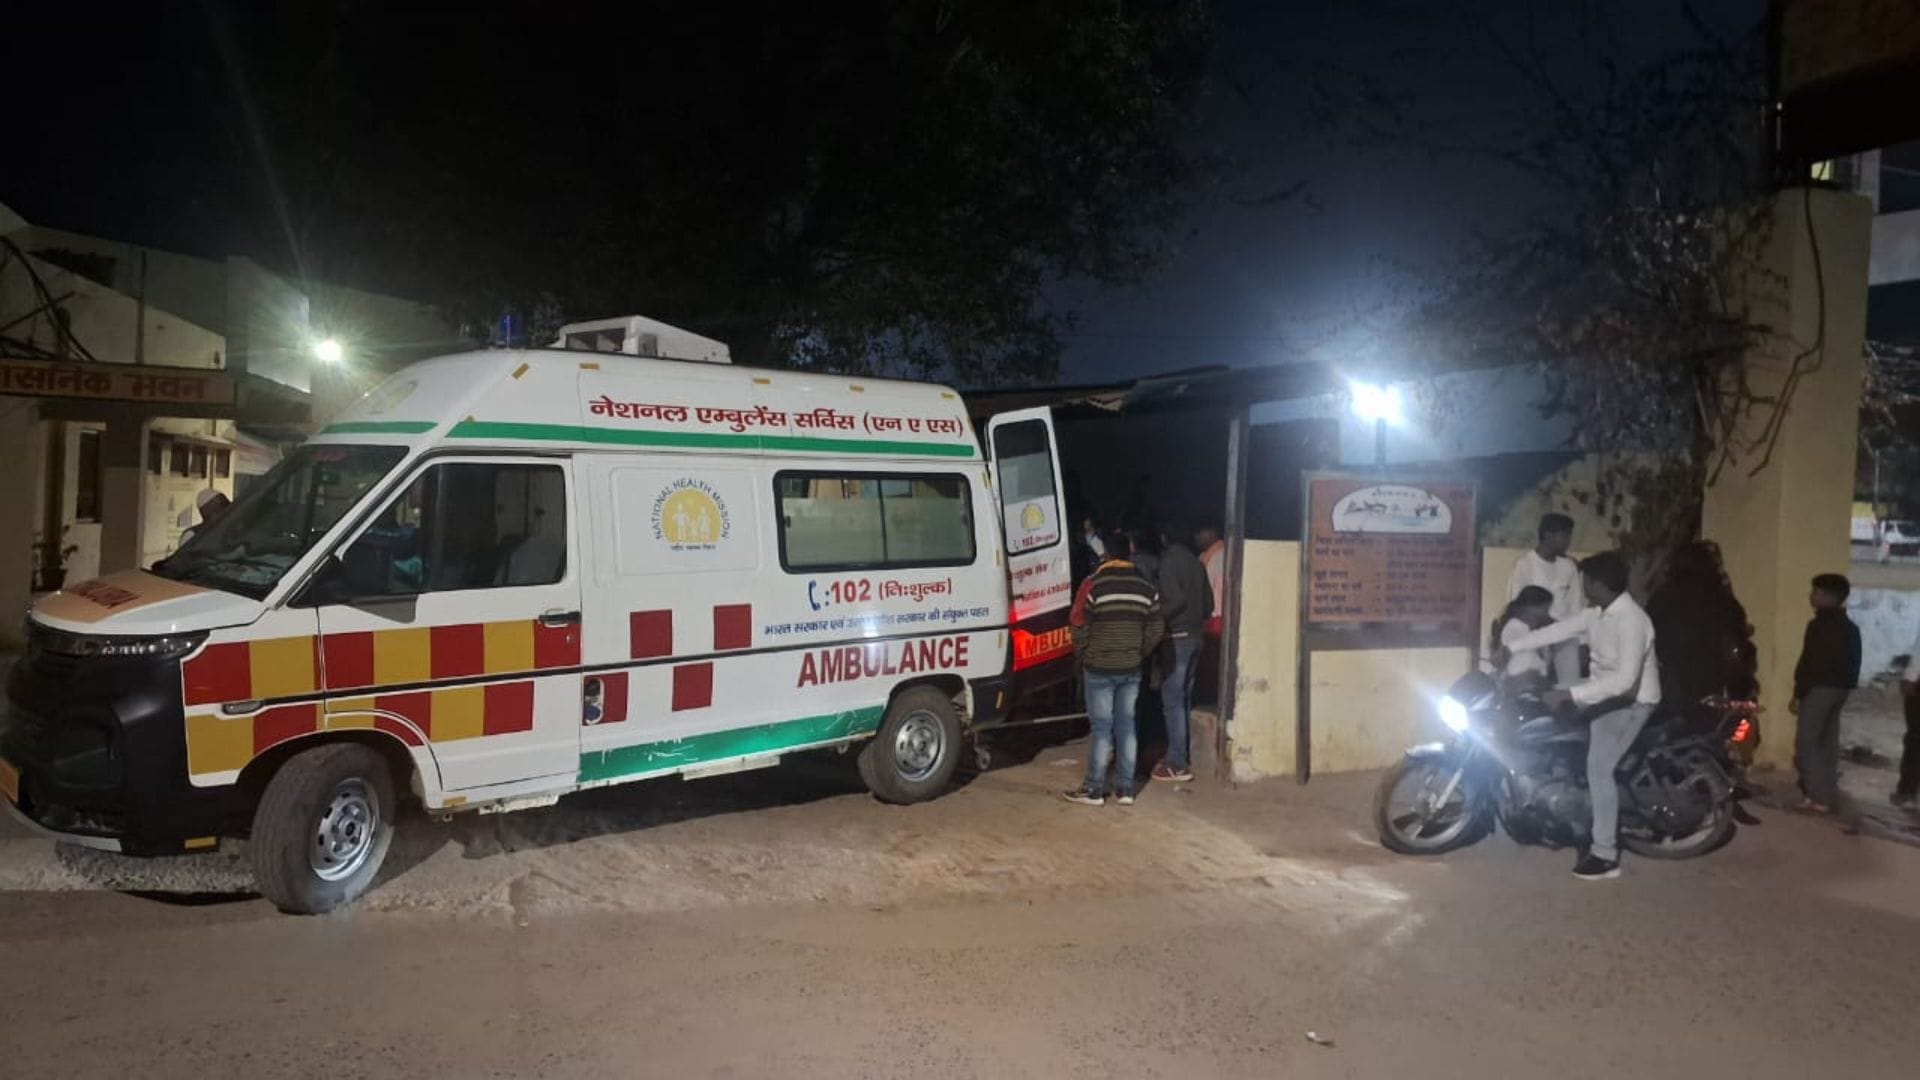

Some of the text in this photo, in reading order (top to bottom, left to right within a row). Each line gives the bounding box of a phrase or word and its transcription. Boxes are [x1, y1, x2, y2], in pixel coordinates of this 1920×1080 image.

[122, 373, 209, 399] भवन
[589, 395, 964, 437] नेशनल एम्बुलेंस सर्विस (एन ए एस)
[651, 477, 730, 540] NATIONAL HEALTH MISSION
[764, 623, 791, 635] भारत
[794, 620, 828, 633] सरकार
[797, 635, 970, 688] AMBULANCE
